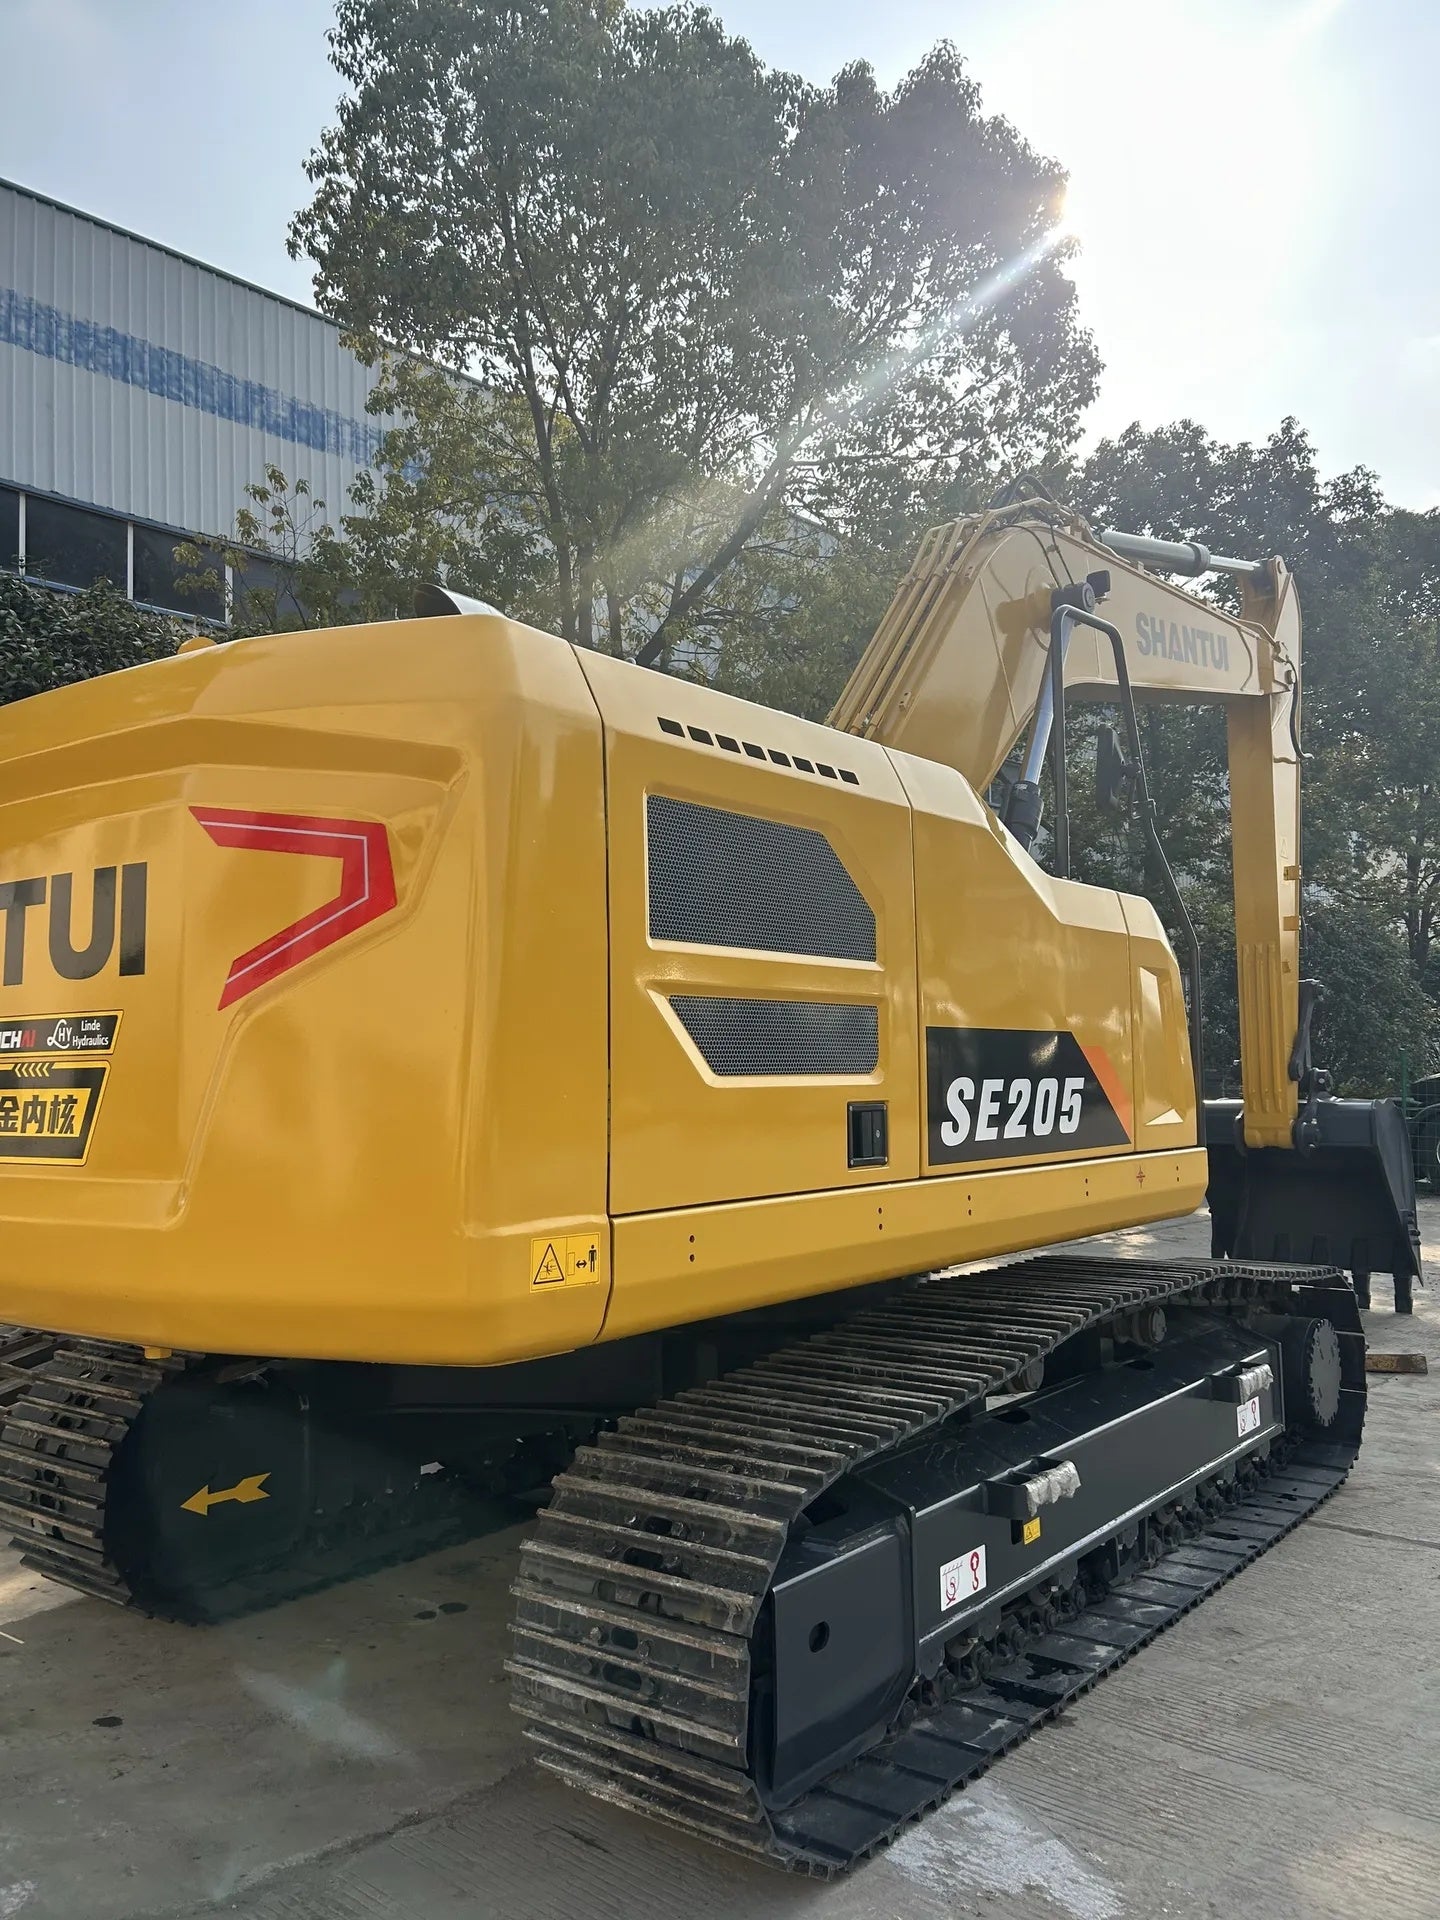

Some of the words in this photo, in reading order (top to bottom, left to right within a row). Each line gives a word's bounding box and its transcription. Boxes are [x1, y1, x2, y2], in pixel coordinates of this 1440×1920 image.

[1136, 612, 1229, 672] SHANTUI
[72, 1034, 109, 1049] Hydraulics
[81, 1019, 101, 1031] Linde
[0, 1095, 78, 1134] 金内核
[940, 1076, 1085, 1147] SE205
